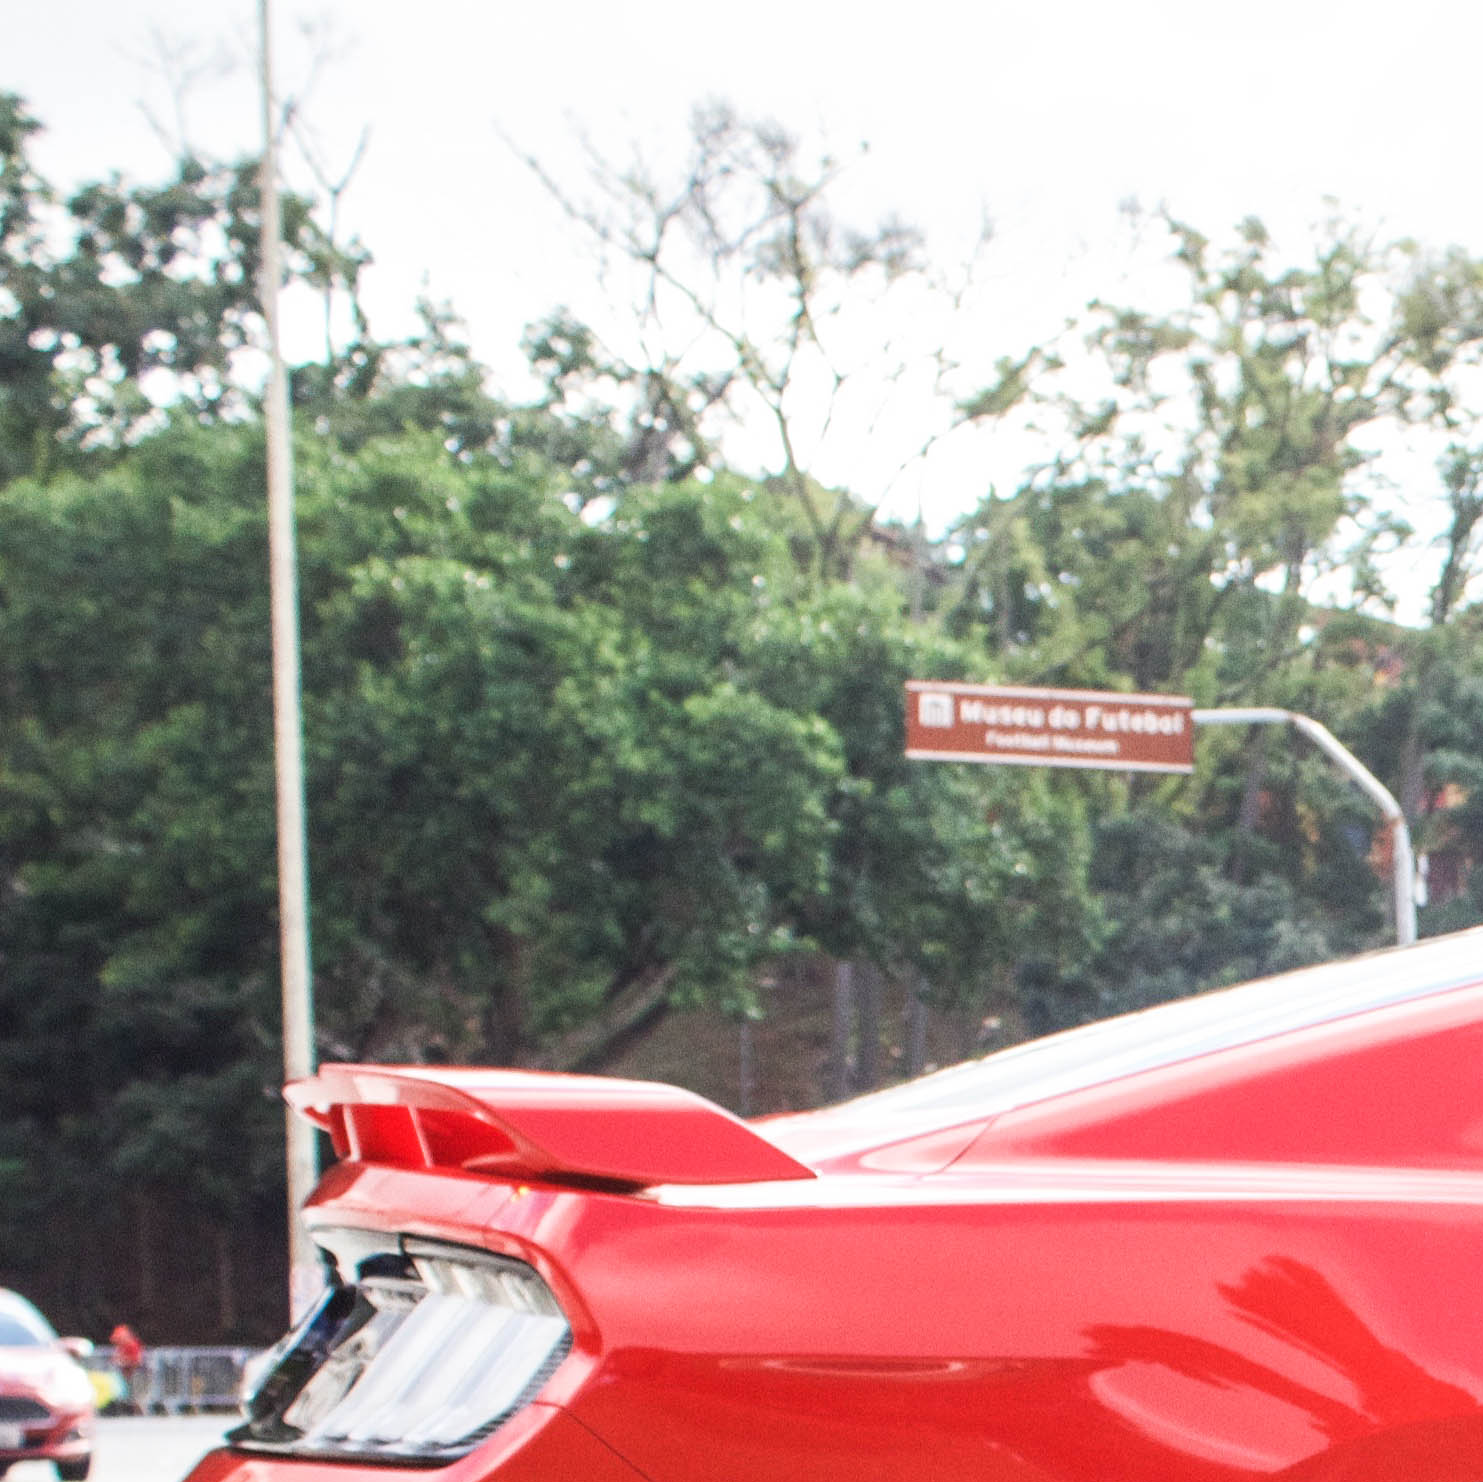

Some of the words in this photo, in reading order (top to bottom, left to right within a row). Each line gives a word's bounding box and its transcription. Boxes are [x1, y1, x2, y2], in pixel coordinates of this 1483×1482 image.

[961, 700, 1045, 727] Museu
[1049, 706, 1080, 729] do
[1085, 706, 1184, 735] Futebol
